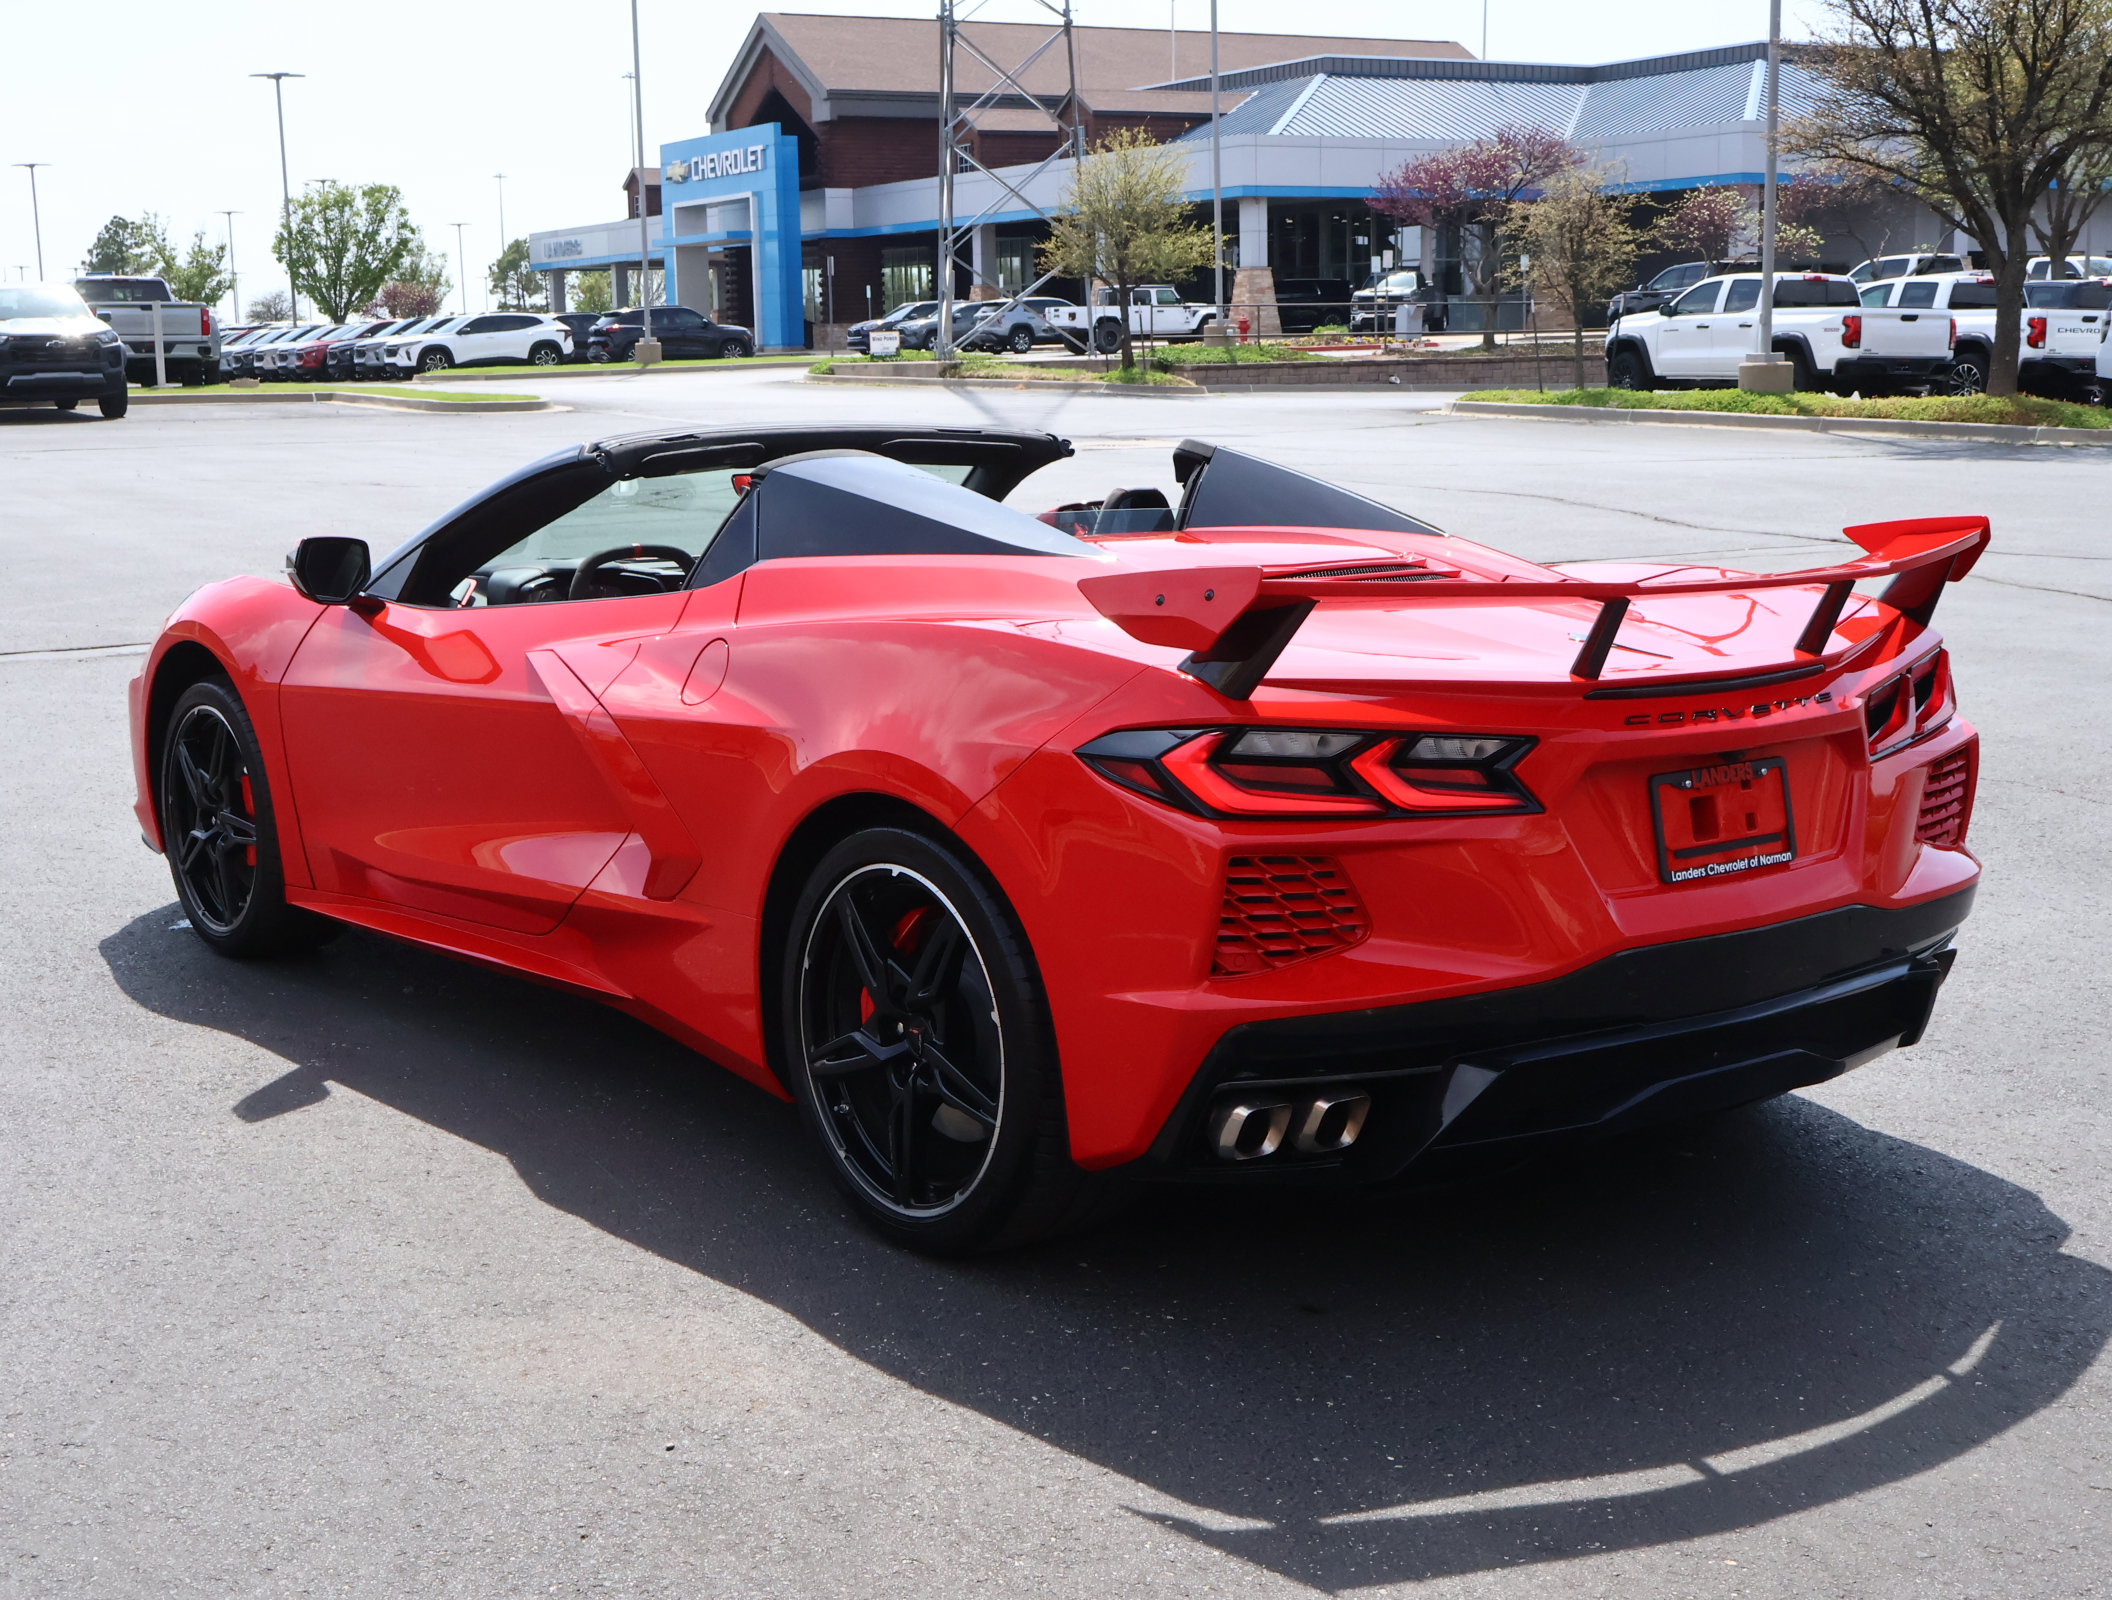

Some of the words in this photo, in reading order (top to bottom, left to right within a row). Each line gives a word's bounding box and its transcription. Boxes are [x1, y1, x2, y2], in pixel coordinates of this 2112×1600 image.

[691, 144, 764, 181] CHEVROLET
[1624, 691, 1833, 726] CORVETTE
[1691, 762, 1753, 789] LANDERS
[1671, 867, 1706, 882] Landers
[1707, 857, 1749, 875] Chevrolet
[1750, 855, 1759, 868] of
[1760, 852, 1793, 866] Norman
